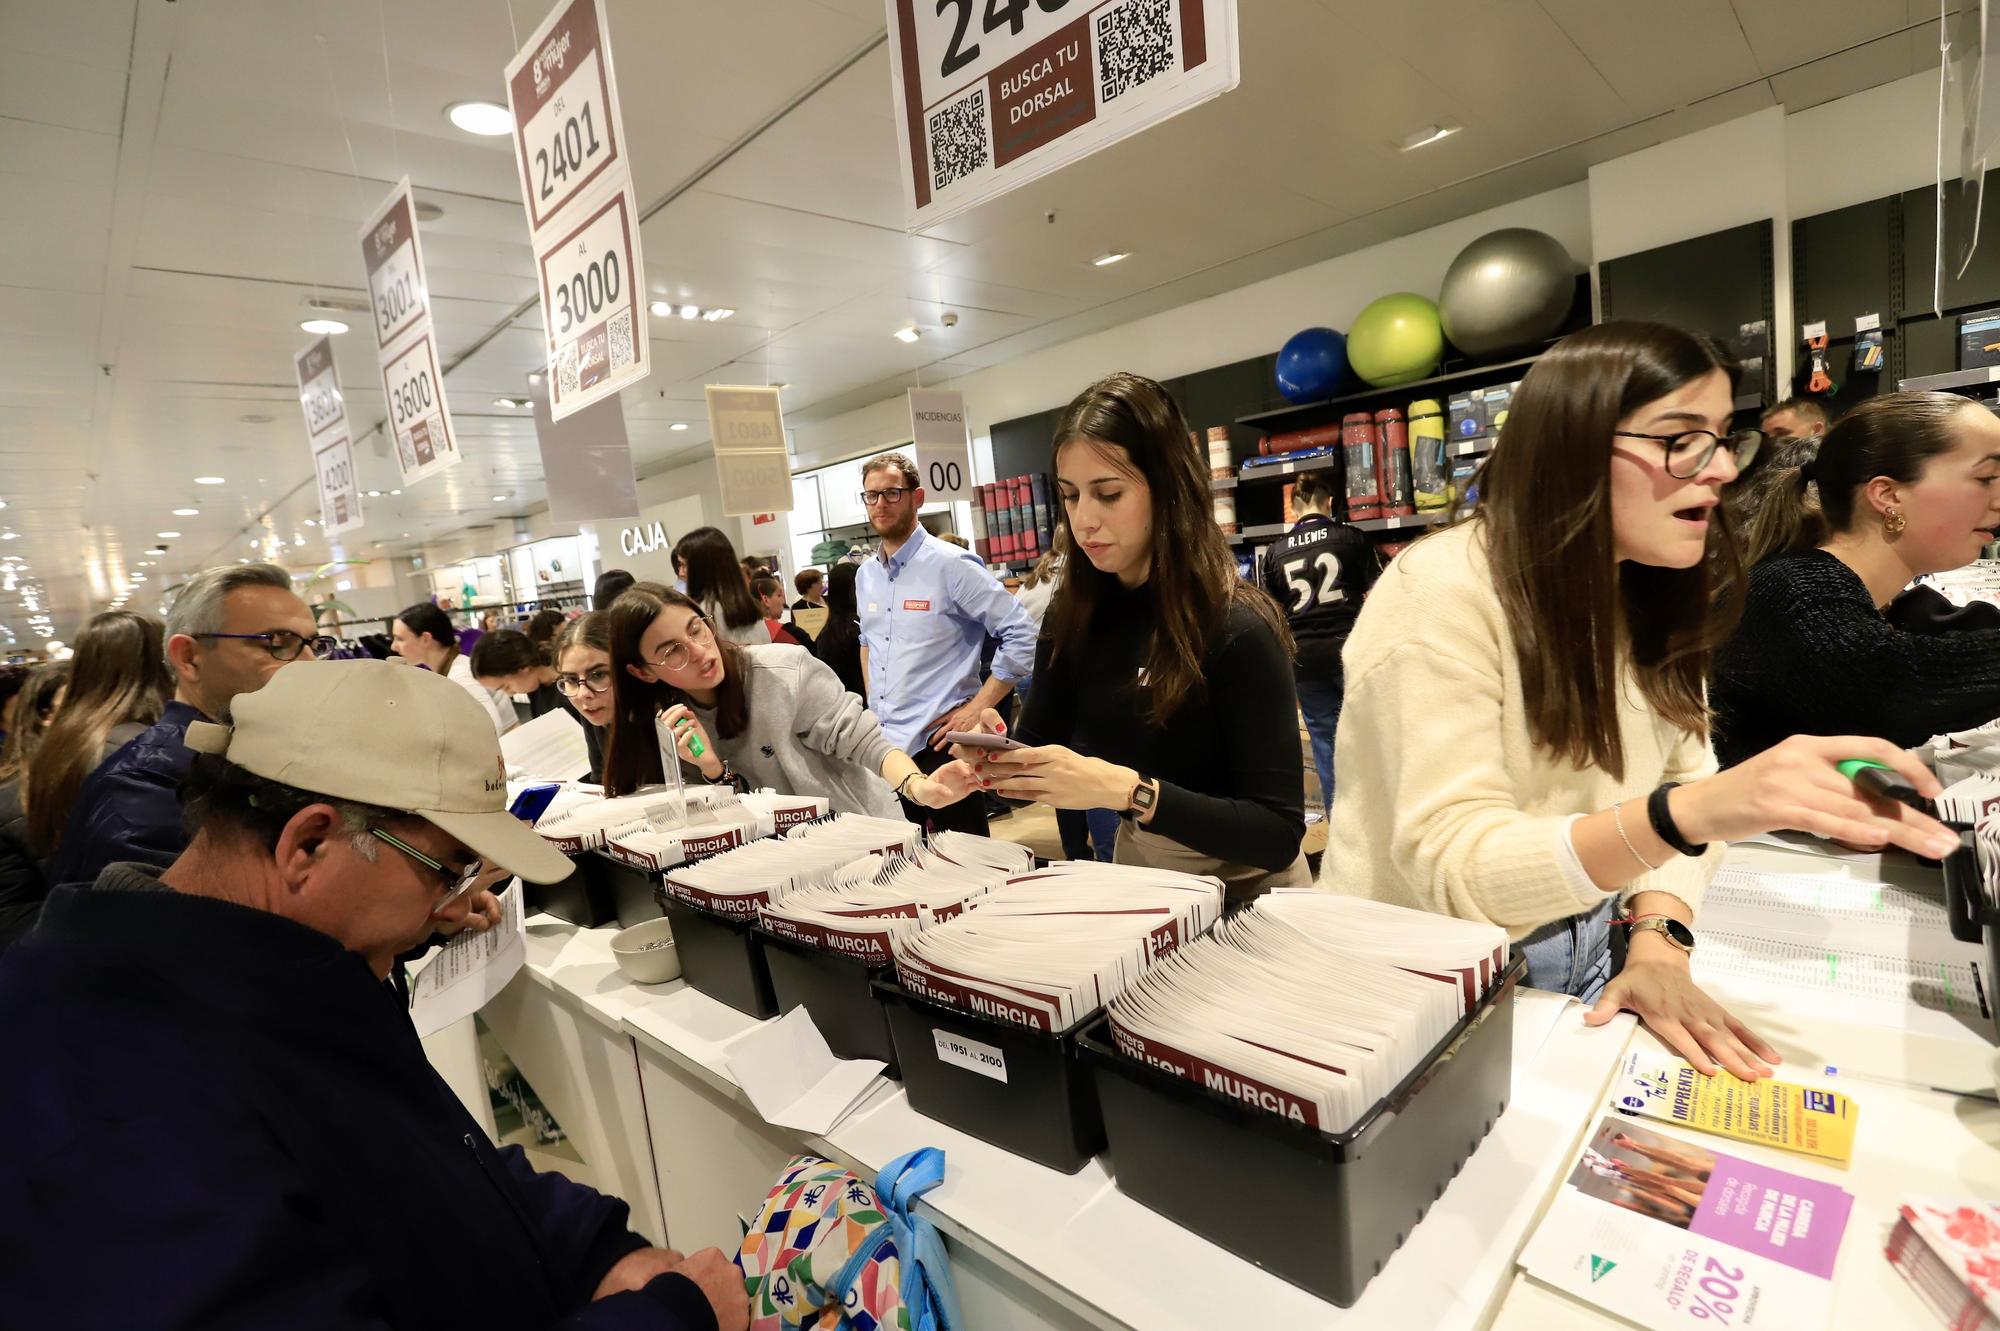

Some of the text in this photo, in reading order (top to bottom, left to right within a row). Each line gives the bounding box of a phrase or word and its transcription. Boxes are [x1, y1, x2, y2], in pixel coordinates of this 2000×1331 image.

[1000, 40, 1079, 101] BUSCA TU
[554, 95, 566, 118] DEL
[1010, 77, 1075, 125] DORSAL
[536, 100, 600, 201] 2401
[578, 241, 588, 257] AL
[378, 270, 416, 331] 3001
[556, 249, 621, 334] 3000
[394, 370, 432, 424] 3600
[915, 411, 962, 423] INCIDENCIAS
[929, 462, 962, 492] 00
[620, 521, 669, 557] CAJA
[1283, 552, 1344, 613] 52
[775, 810, 813, 823] URCIA
[550, 840, 579, 852] RCIA
[684, 837, 730, 854] MURCIA
[711, 897, 760, 912] MURCIA
[774, 919, 797, 932] carrera
[826, 932, 884, 953] MURCIA
[866, 953, 887, 962] 2023
[899, 965, 927, 986] carrera
[969, 993, 1041, 1029] MURCIA
[1112, 1024, 1146, 1052] carrera
[938, 1039, 1003, 1068] DEL 1951 AL 2100
[1203, 1068, 1307, 1124] MURCIA
[1672, 1067, 1695, 1121] IMPRENTA
[1714, 1177, 1739, 1216] de dorsales
[1734, 1182, 1757, 1215] Recogida
[1753, 1188, 1780, 1232] DE MURCIA
[1780, 1193, 1797, 1208] DE
[1777, 1205, 1794, 1219] LA
[1791, 1199, 1815, 1238] CARRERA
[1684, 1248, 1698, 1264] DE
[1688, 1255, 1746, 1327] 20%
